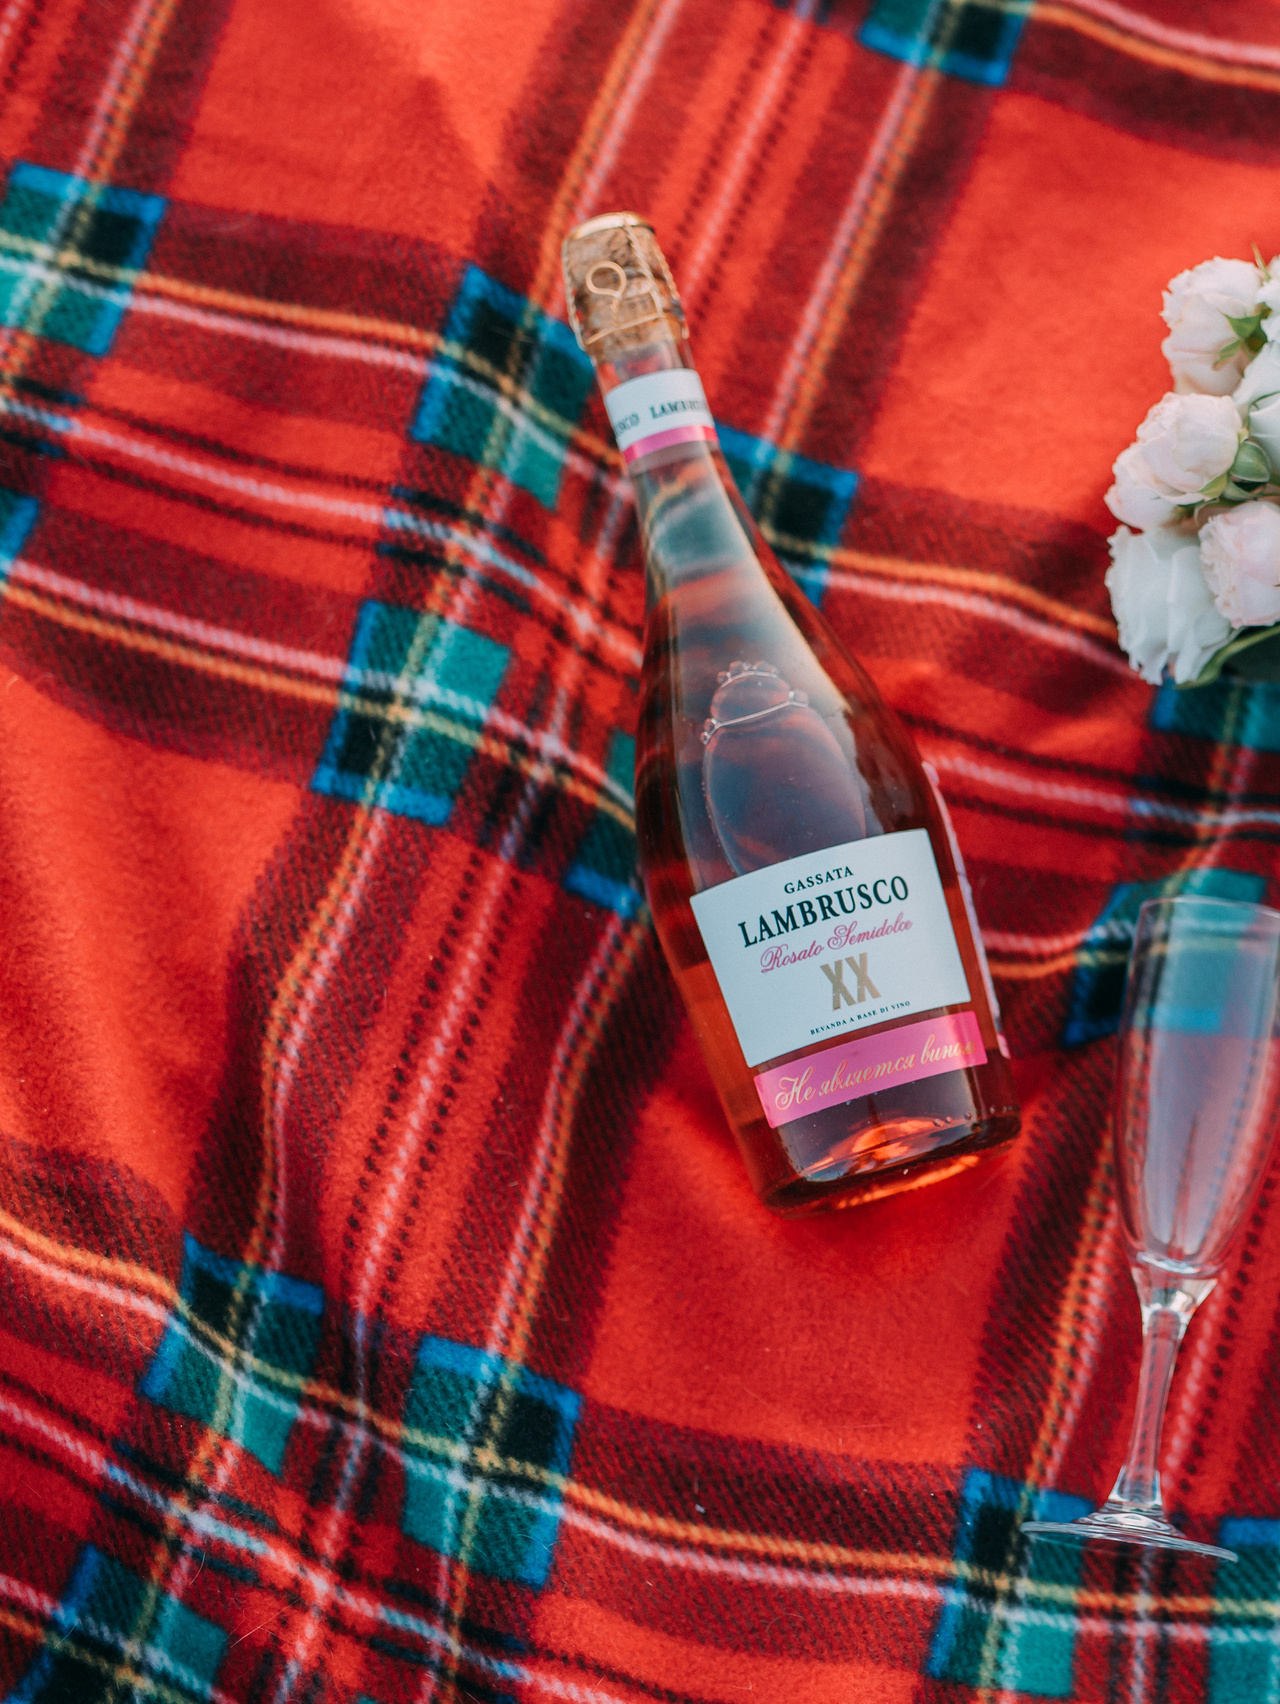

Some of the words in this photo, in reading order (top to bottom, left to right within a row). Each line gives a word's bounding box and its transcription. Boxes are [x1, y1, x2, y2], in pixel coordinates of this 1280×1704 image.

[784, 865, 854, 895] GASSATA
[737, 875, 910, 948] LAMBRUSCO
[760, 944, 824, 974] Rosato
[827, 912, 913, 949] Semidolce
[820, 952, 882, 1011] XX
[810, 1019, 847, 1035] BEVANDA
[857, 1010, 878, 1021] BASE
[891, 1000, 911, 1010] VINO
[775, 1066, 817, 1111] Не
[818, 1059, 917, 1097] является
[920, 1034, 976, 1065] вином
